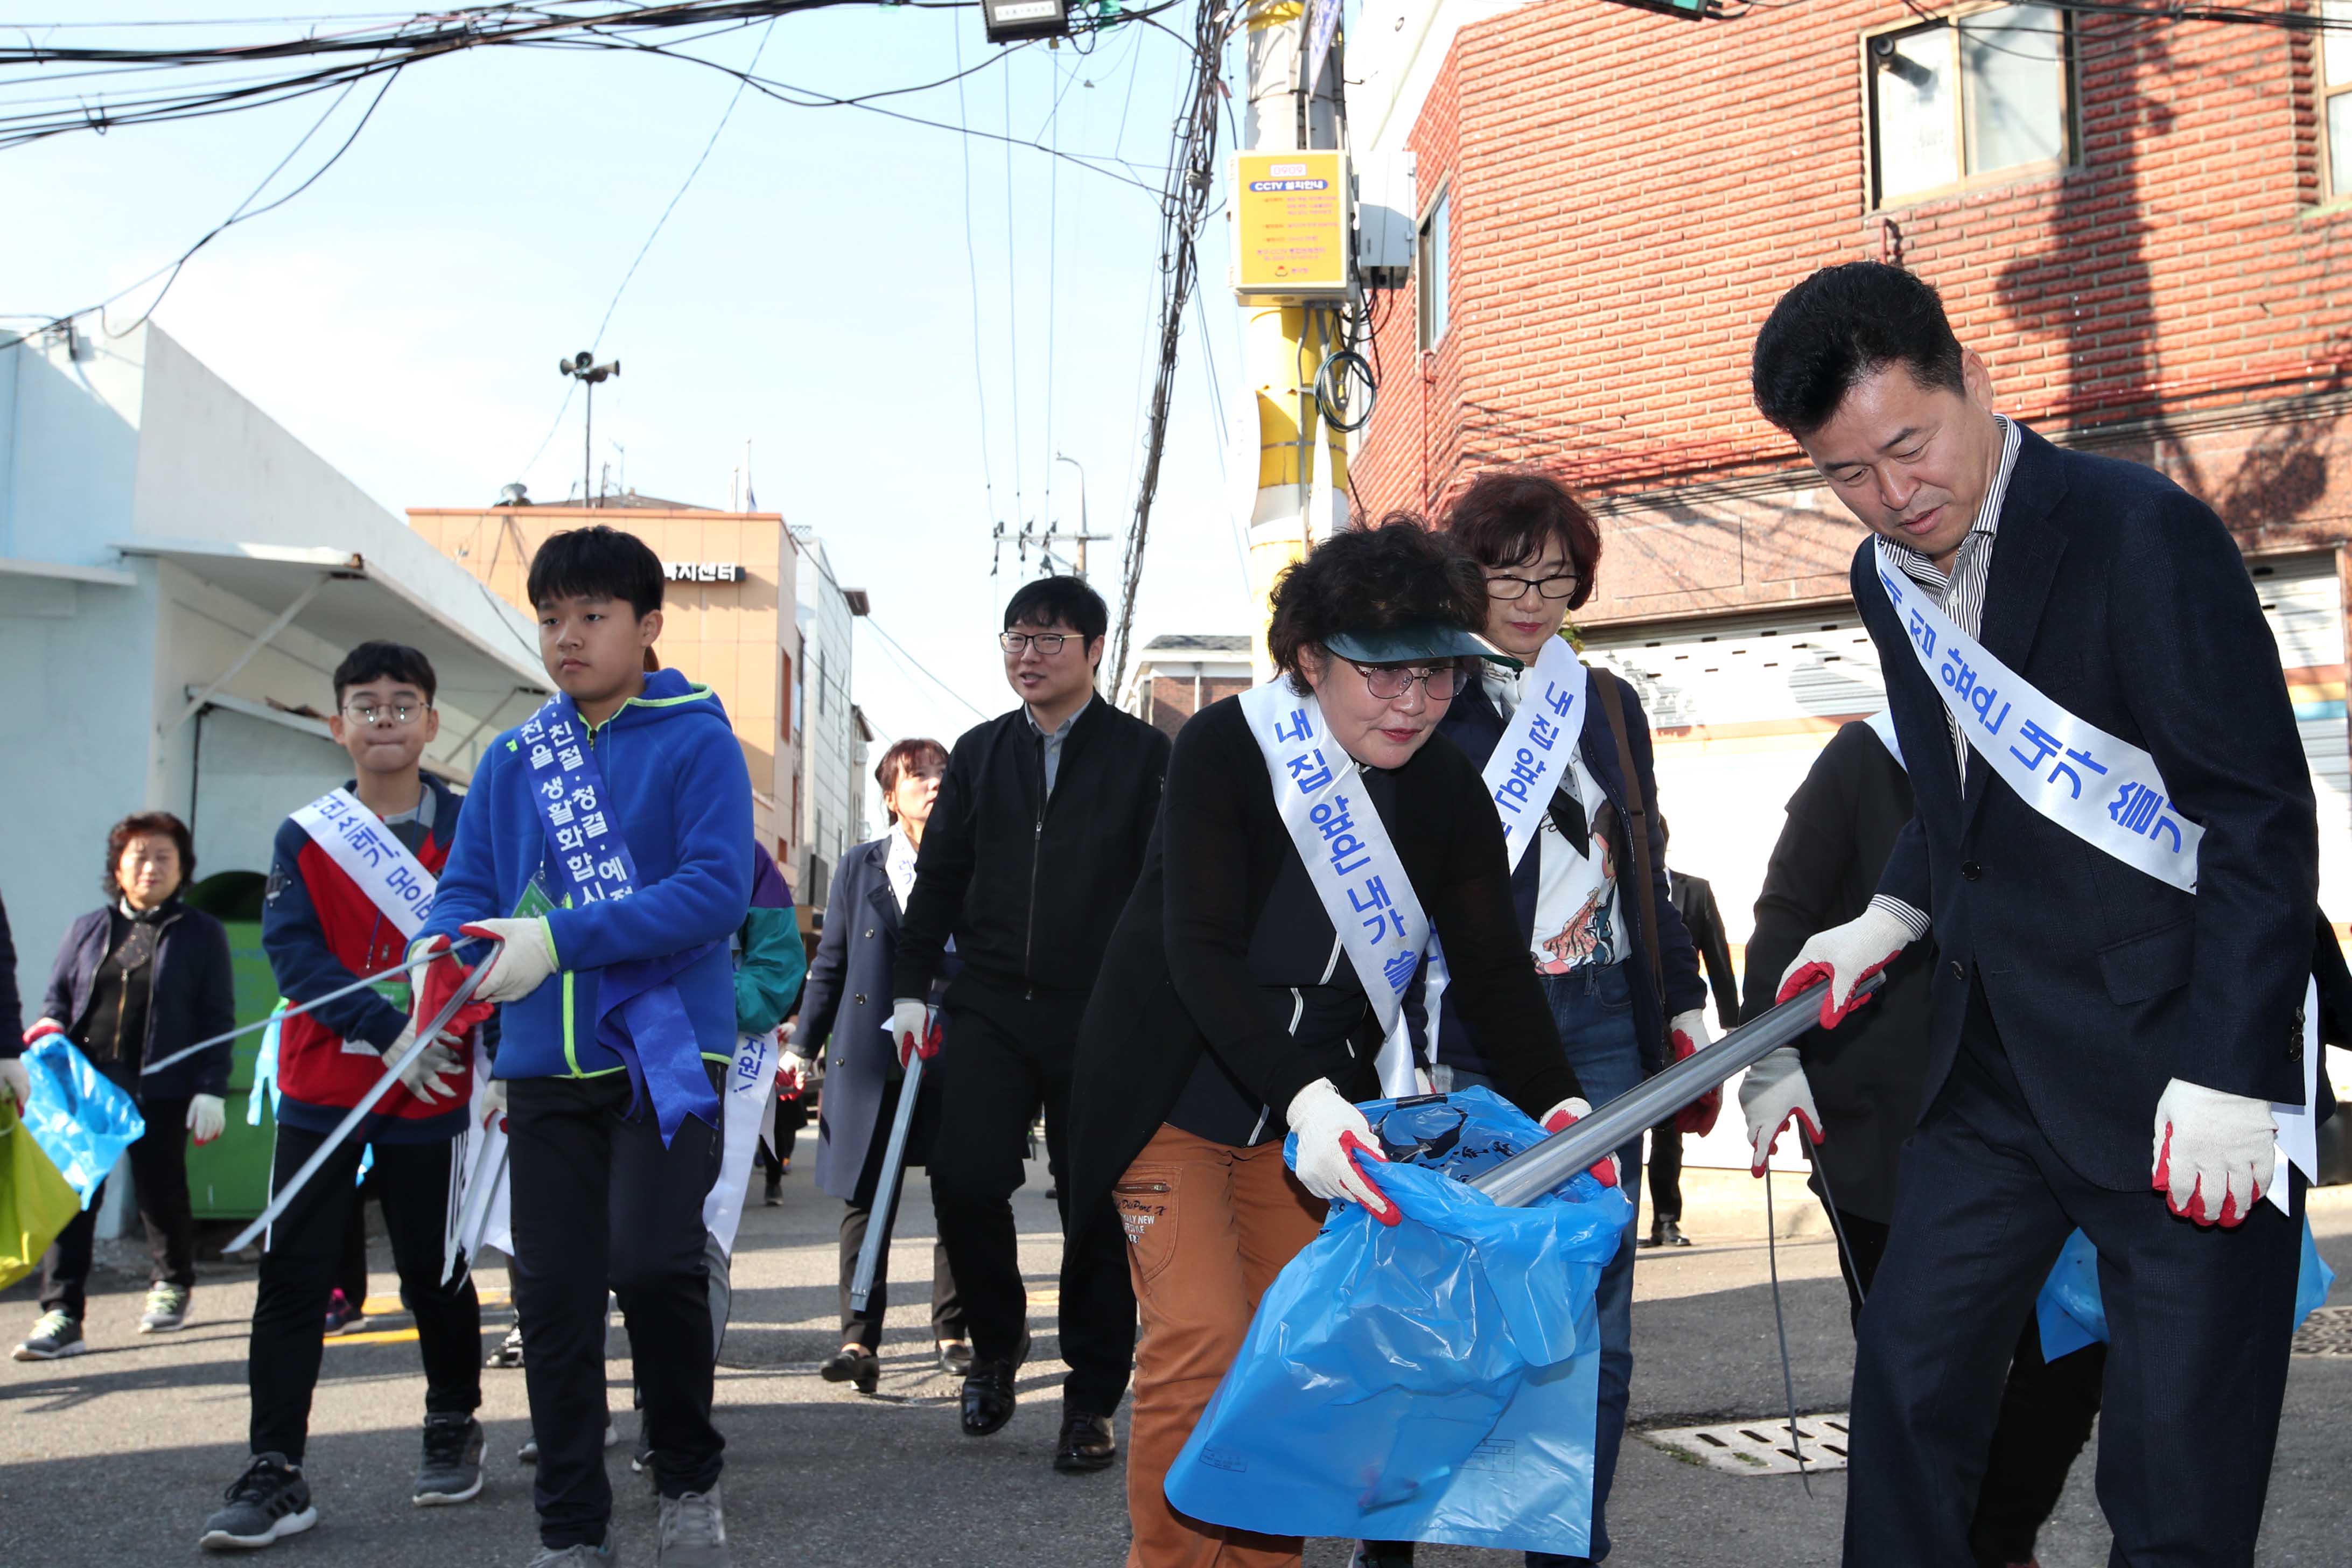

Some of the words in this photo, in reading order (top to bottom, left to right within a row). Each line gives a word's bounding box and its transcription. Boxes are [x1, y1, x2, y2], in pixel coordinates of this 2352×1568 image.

[1255, 181, 1283, 191] CCTV
[1545, 681, 1574, 718] 내
[1909, 608, 1936, 659] 집
[1941, 648, 2011, 736] 앞은
[2010, 719, 2108, 800] 내가
[1275, 709, 1313, 743] 내
[1529, 713, 1559, 751] 집
[1286, 748, 1333, 794] 집
[1494, 748, 1546, 814] 앞은
[1309, 795, 1371, 876] 앞은
[1347, 875, 1406, 946] 내가
[1138, 1215, 1154, 1224] NEW
